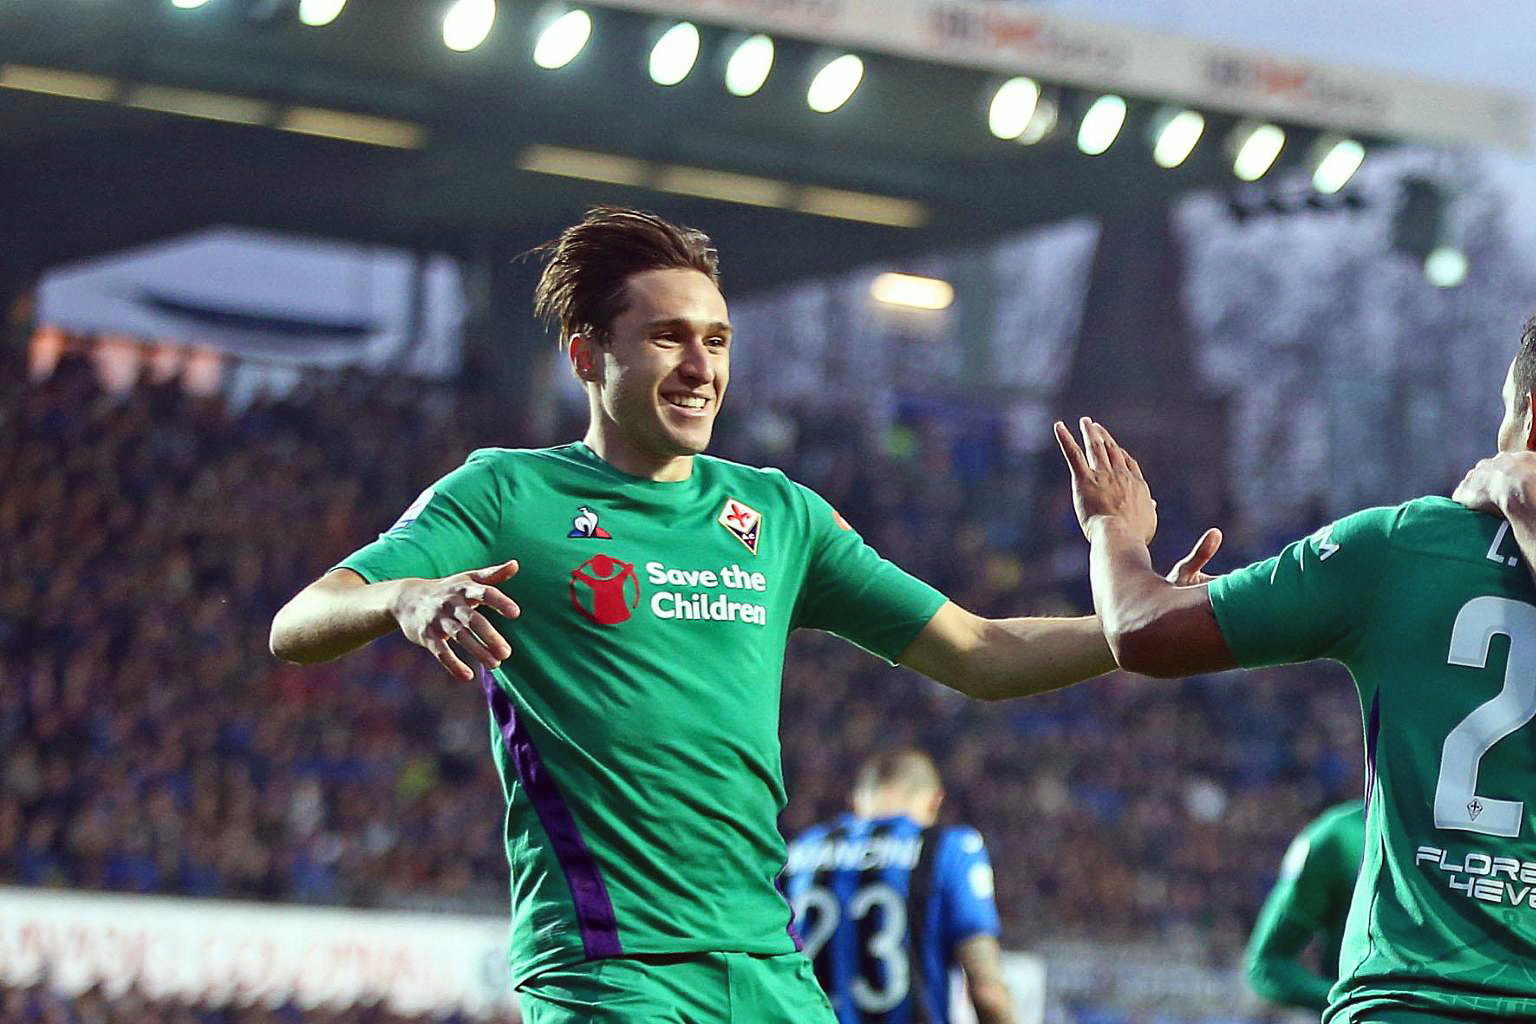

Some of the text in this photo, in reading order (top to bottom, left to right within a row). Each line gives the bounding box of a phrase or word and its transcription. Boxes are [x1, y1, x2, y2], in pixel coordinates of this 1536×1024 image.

[645, 561, 767, 593] Save the
[650, 591, 767, 626] Children
